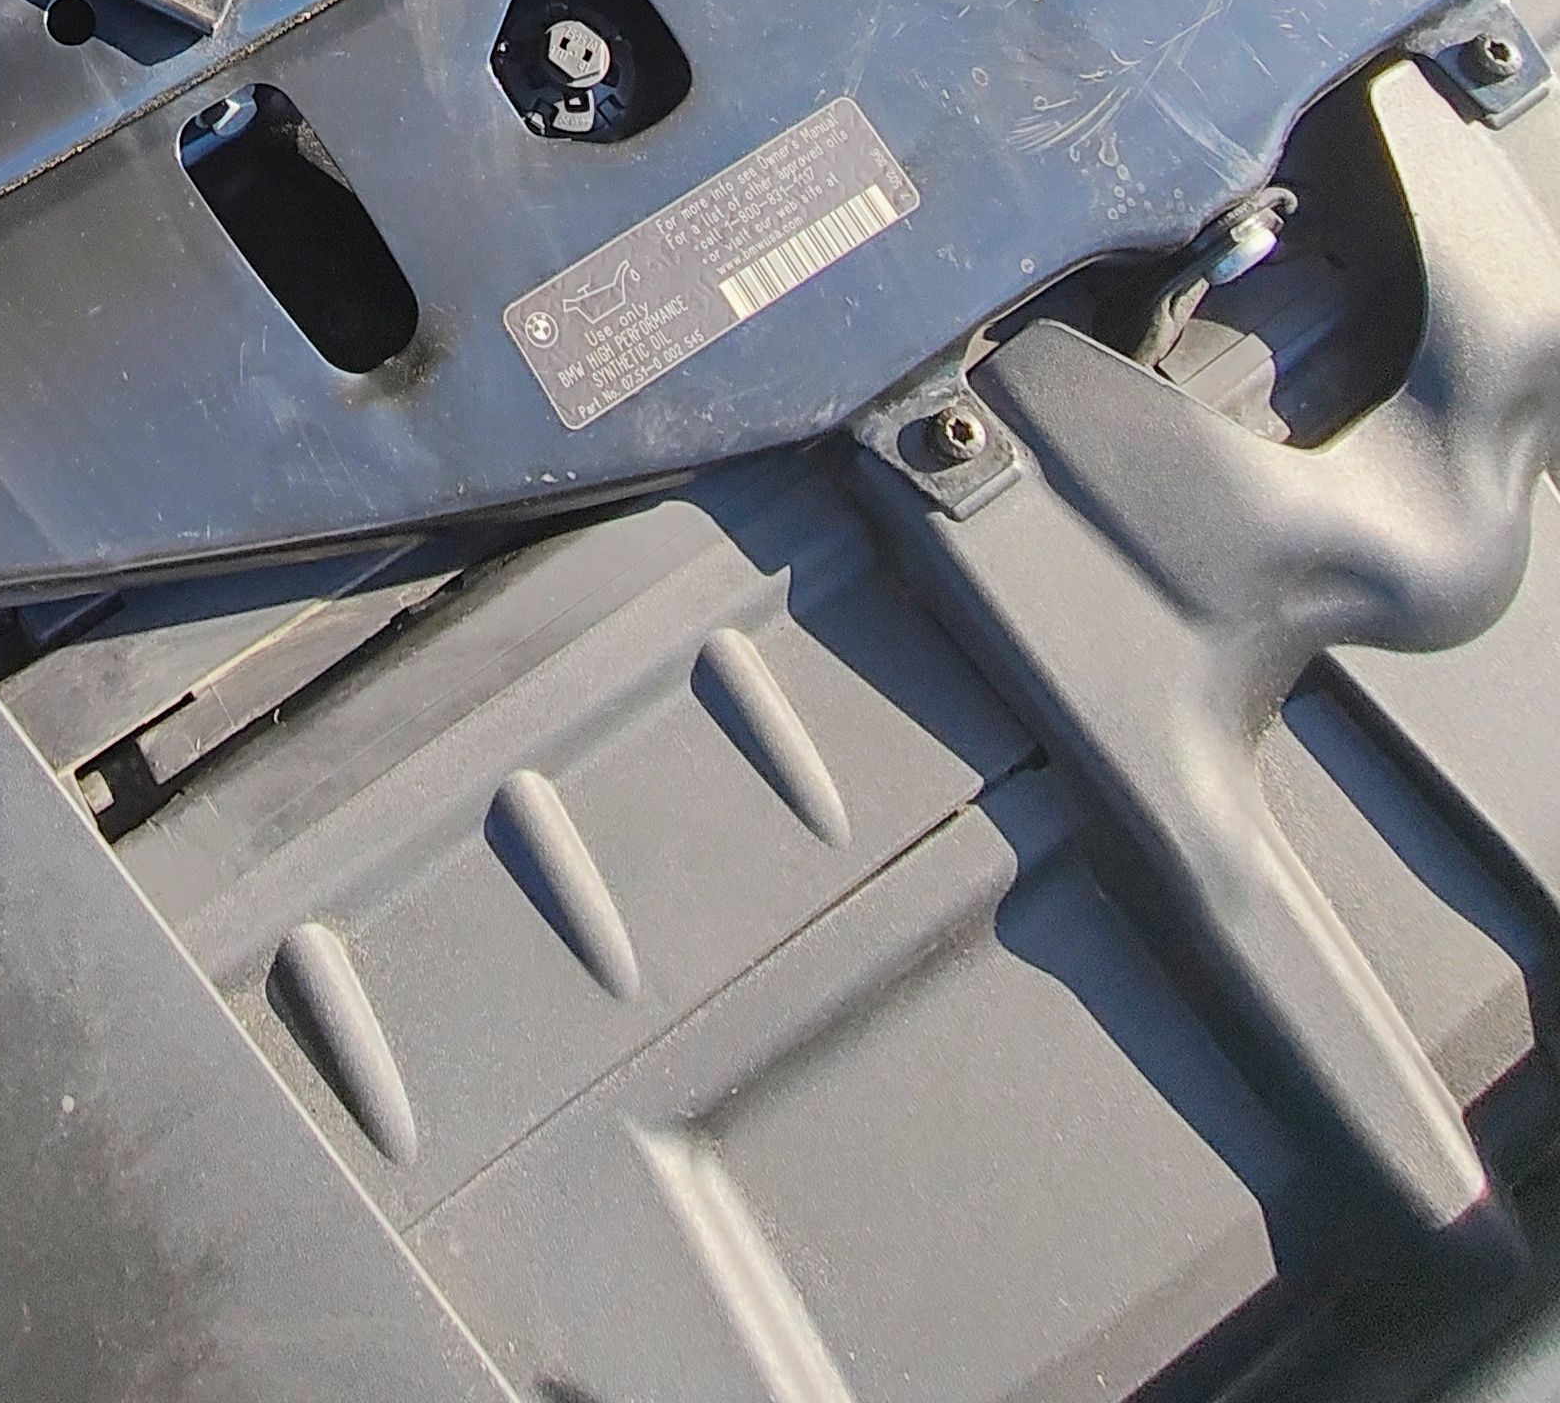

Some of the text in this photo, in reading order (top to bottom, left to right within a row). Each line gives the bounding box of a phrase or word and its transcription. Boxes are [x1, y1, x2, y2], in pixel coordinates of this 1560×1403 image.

[655, 110, 839, 235] For more info see Owner's Manual
[665, 130, 848, 249] For a list of other approved oils
[700, 229, 723, 250] call
[709, 250, 720, 262] or
[755, 217, 771, 232] our
[776, 200, 797, 218] web
[799, 185, 822, 203] site
[826, 172, 839, 187] at
[716, 217, 804, 275] www.bmwusa.com
[558, 295, 688, 388] BMW HIGH PERFORMANCE
[584, 302, 648, 346] Use only
[593, 330, 672, 388] SYNTHETIC OIL
[578, 398, 602, 419] Part
